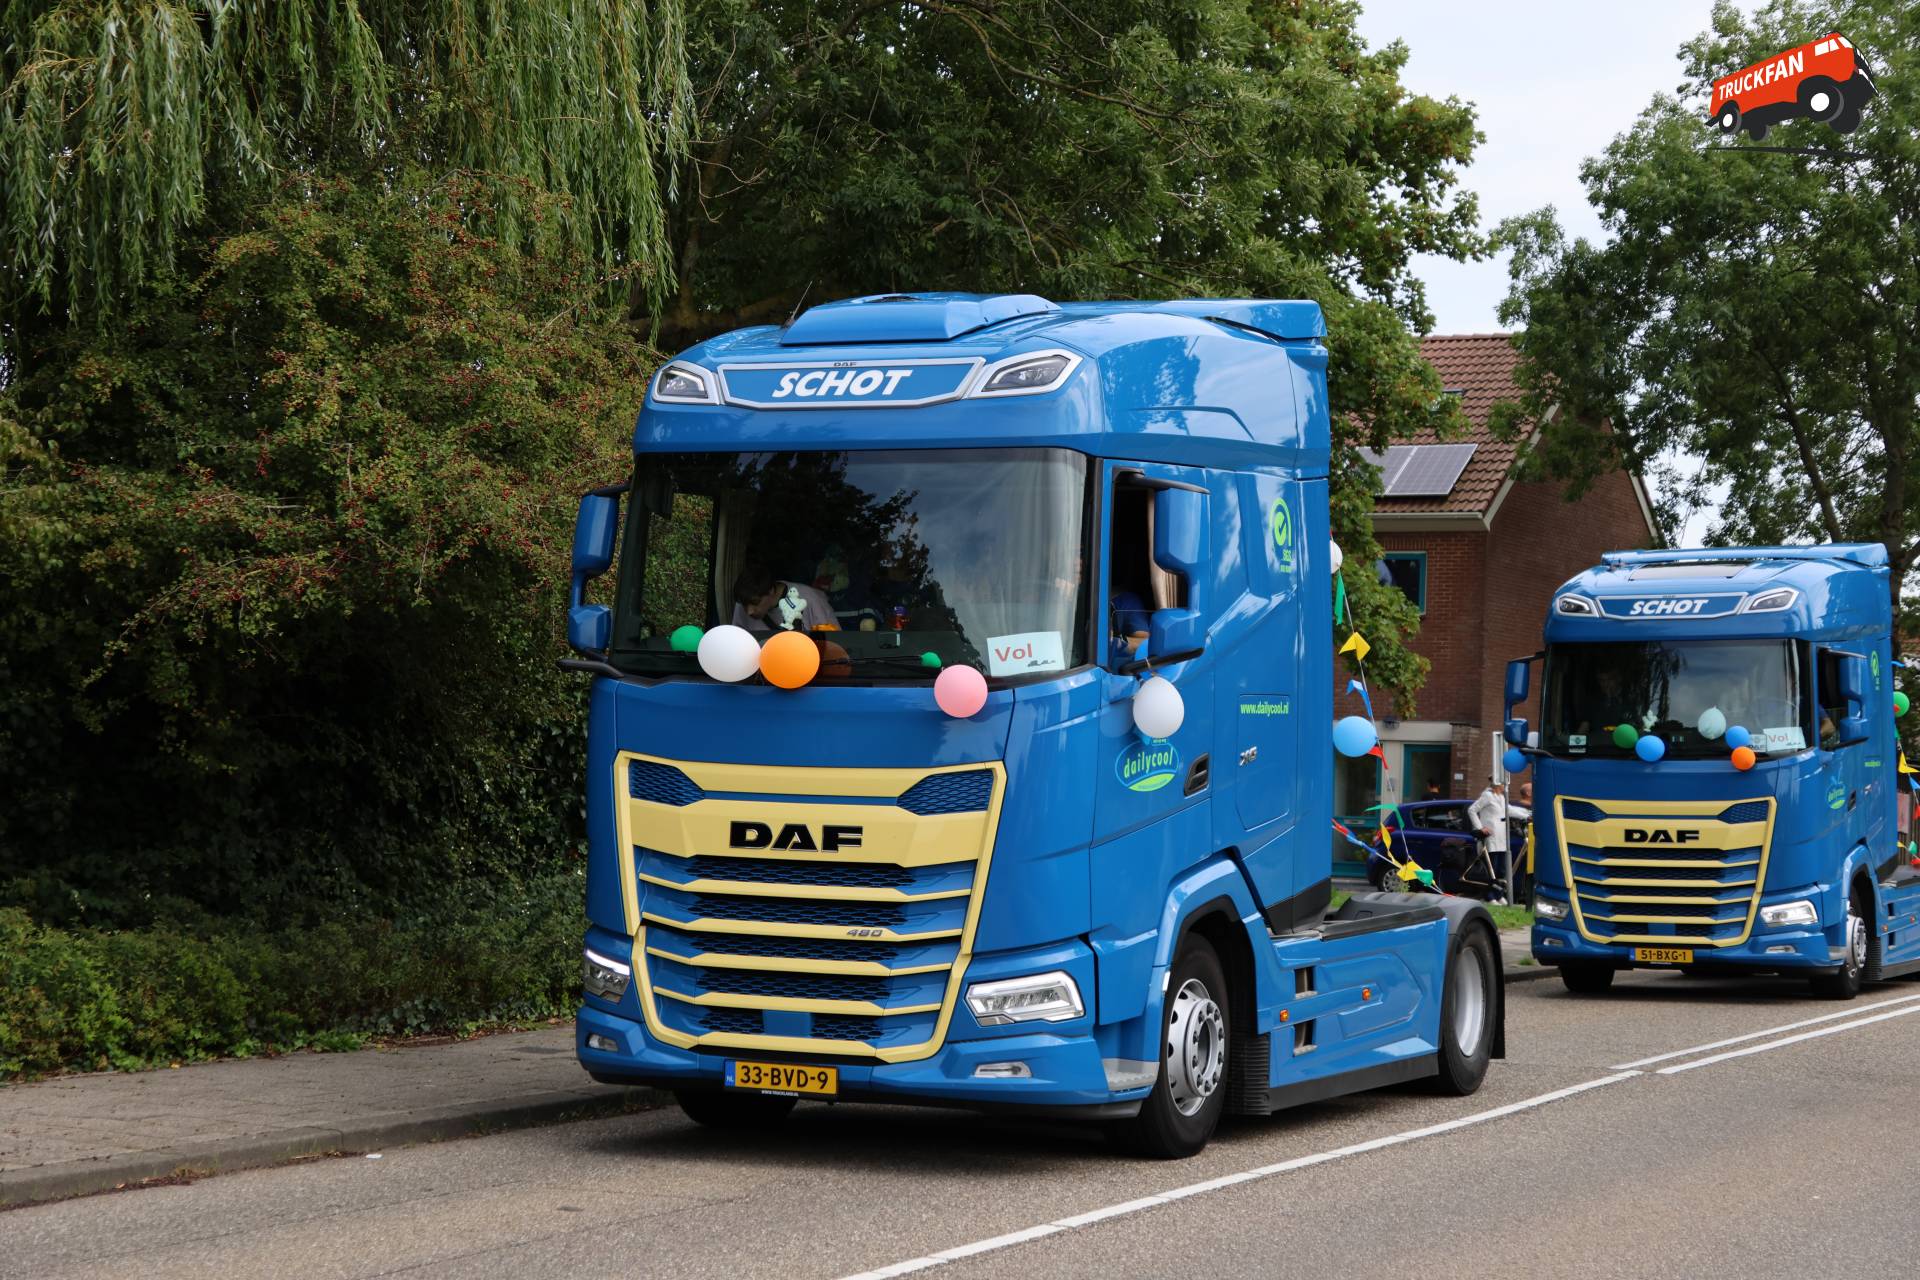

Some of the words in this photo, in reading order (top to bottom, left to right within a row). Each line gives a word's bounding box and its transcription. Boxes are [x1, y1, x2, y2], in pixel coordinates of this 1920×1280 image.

[771, 369, 913, 398] SCHOT
[1629, 599, 1709, 615] SCHOT
[994, 642, 1033, 662] Vol
[1240, 700, 1289, 717] www.dailycool.nl
[1123, 746, 1173, 779] dailycool
[729, 820, 864, 853] DAF
[1624, 829, 1700, 844] DAF
[847, 929, 883, 937] 480
[1641, 949, 1687, 961] 51-BXG-1
[740, 1065, 829, 1090] 33-BVD-9
